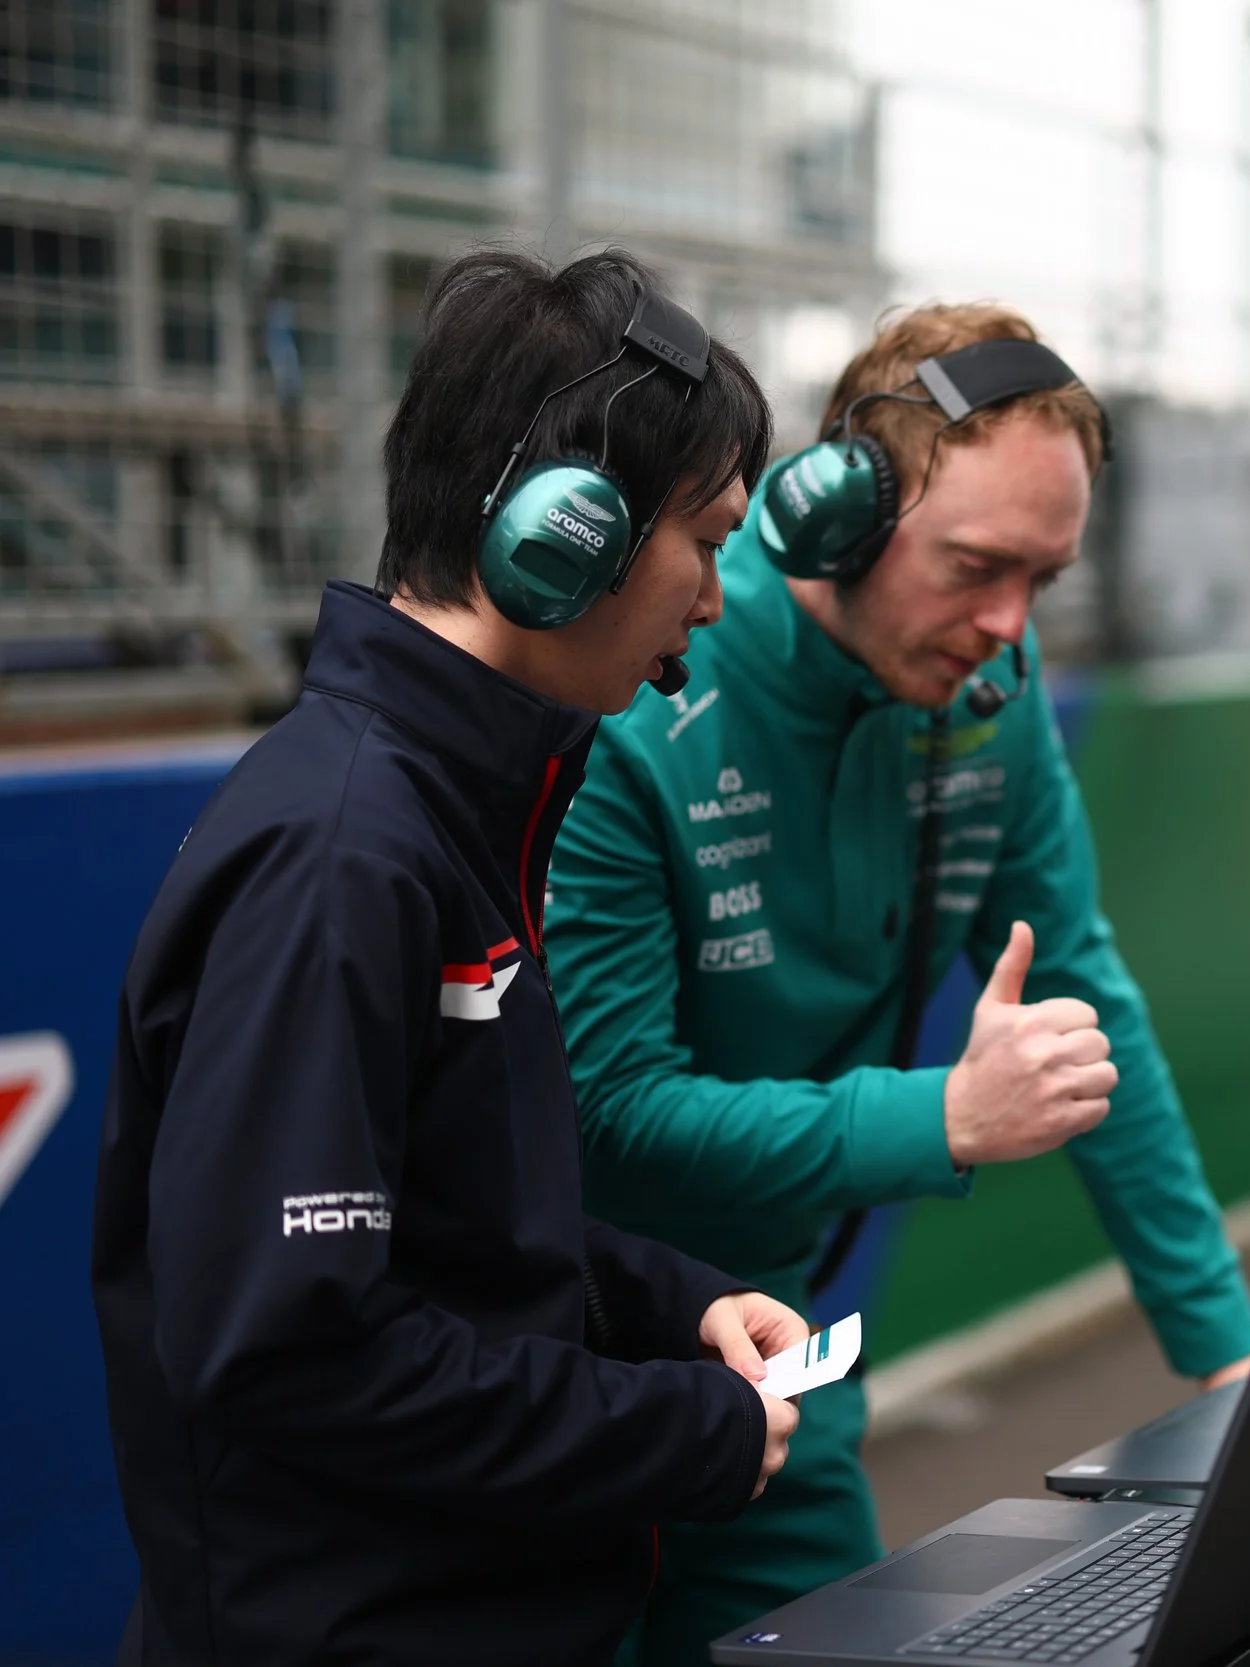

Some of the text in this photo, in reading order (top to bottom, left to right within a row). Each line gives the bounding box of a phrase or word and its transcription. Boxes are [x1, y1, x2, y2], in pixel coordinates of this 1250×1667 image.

[541, 517, 570, 539] FORMULA
[546, 507, 605, 549] aramco
[283, 1192, 375, 1210] Powered
